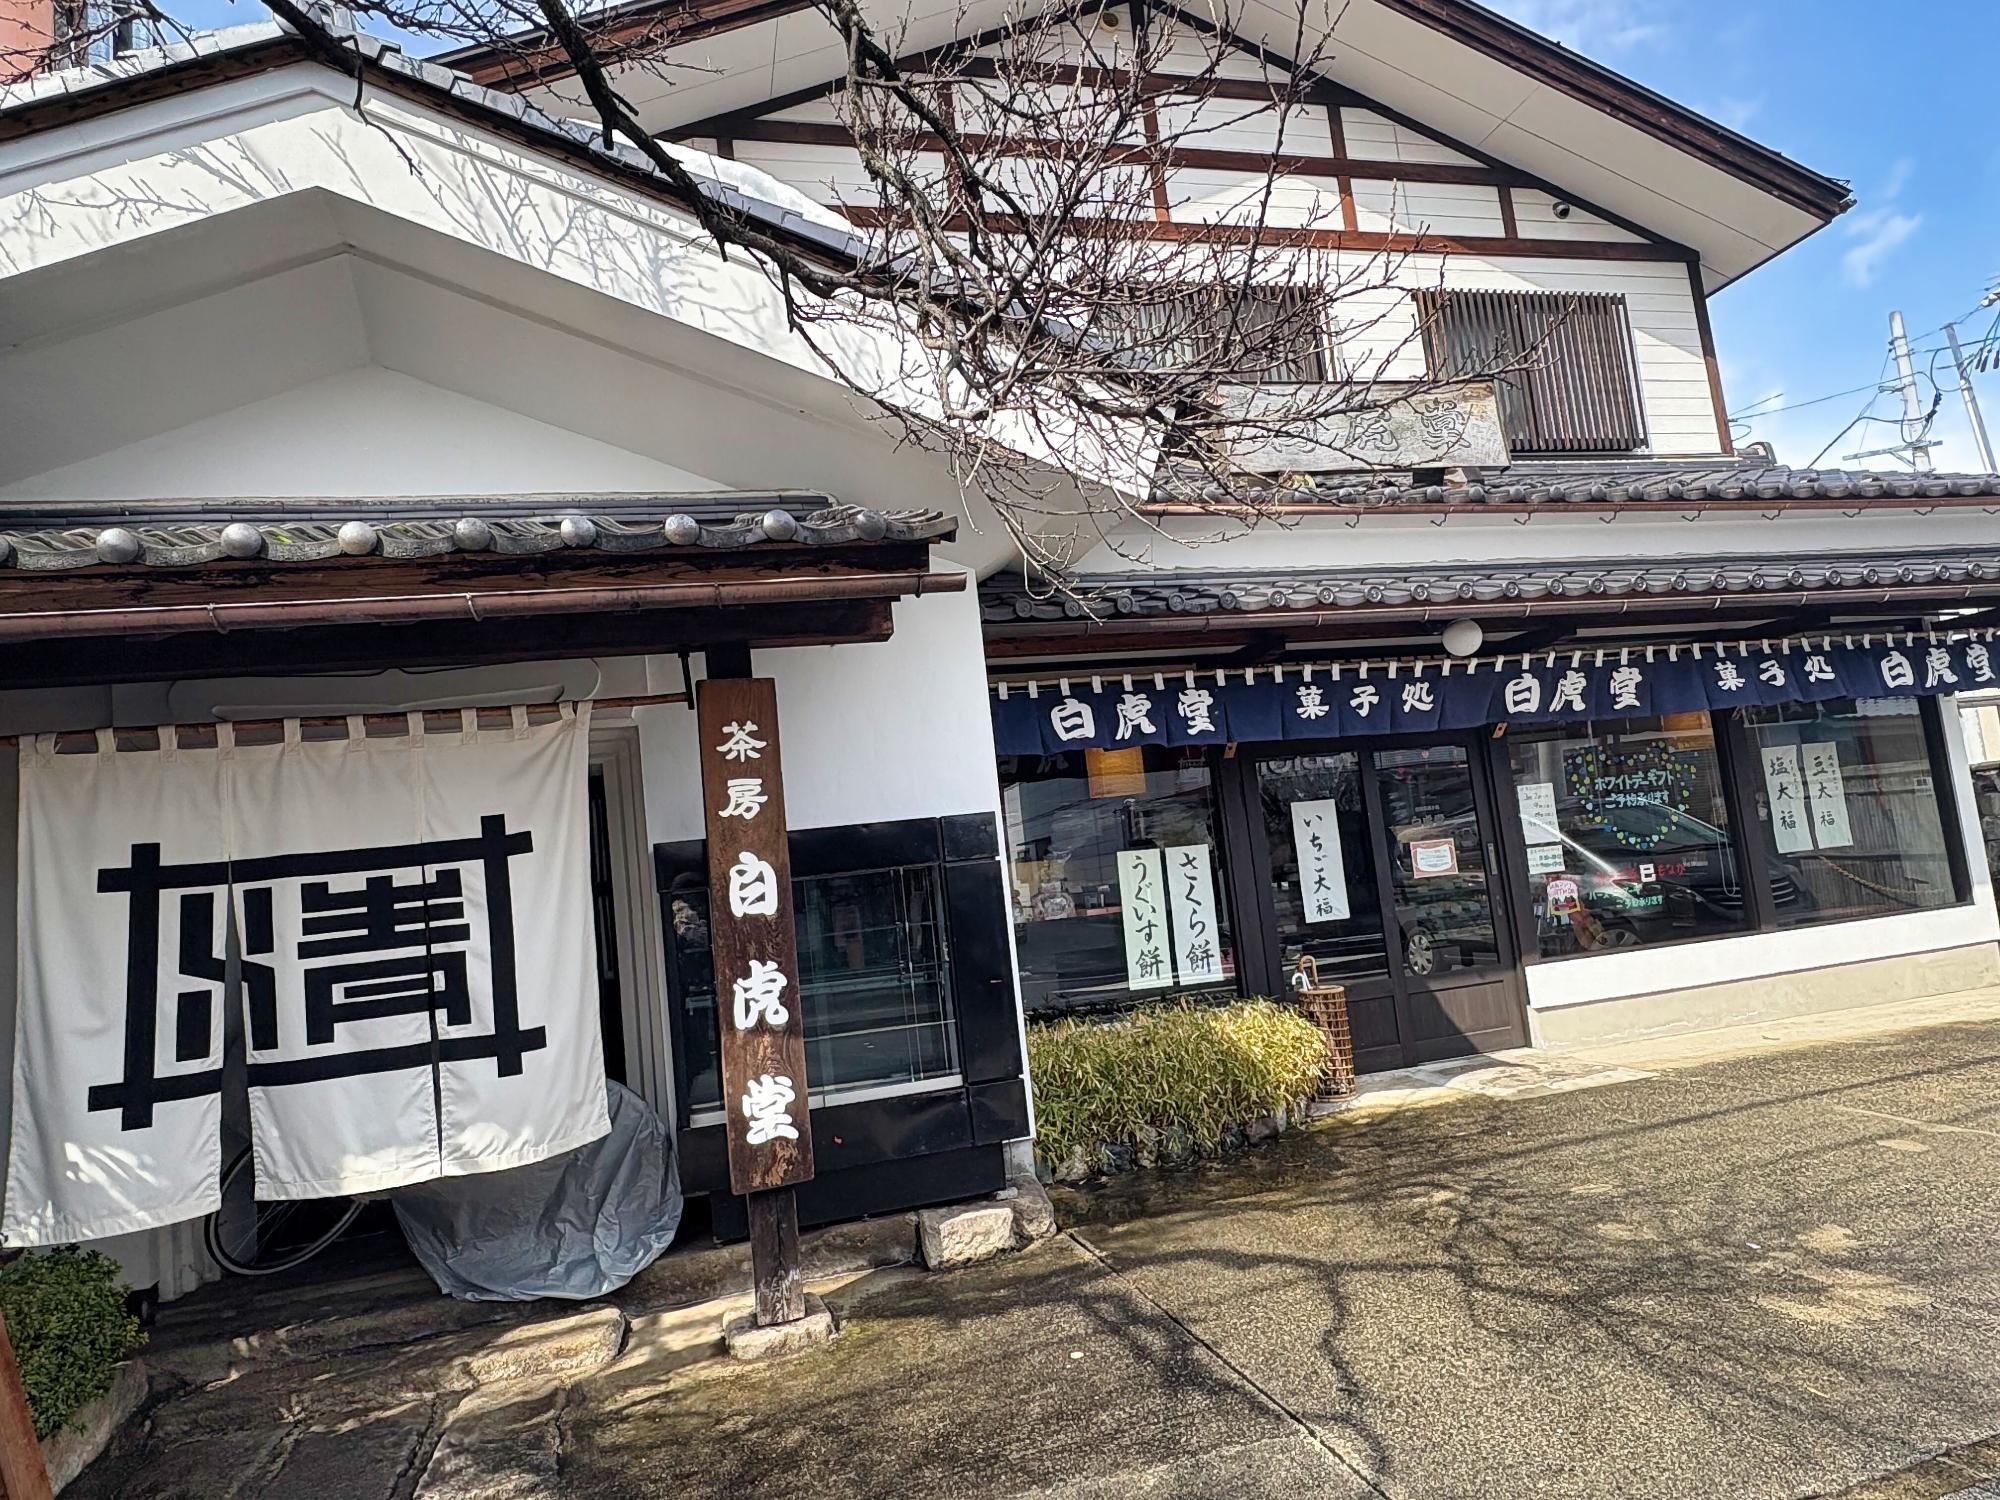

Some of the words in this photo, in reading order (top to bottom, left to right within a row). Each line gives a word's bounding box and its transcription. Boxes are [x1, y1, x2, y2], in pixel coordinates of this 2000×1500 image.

[1051, 690, 1214, 742] 白虎堂
[1296, 682, 1434, 720] 菓子処
[1504, 667, 1643, 713] 白虎堂
[1714, 655, 1835, 691] 菓子処
[1881, 643, 1996, 688] 白虎堂
[716, 721, 768, 820] 茶房
[1594, 768, 1675, 791] ホワイトデーギフト
[1812, 755, 1836, 828] 豆大福
[1179, 852, 1215, 974] さくら餅
[1304, 814, 1333, 917] いちご大福
[1132, 855, 1165, 980] うぐいす餅
[728, 852, 799, 1145] 白虎堂
